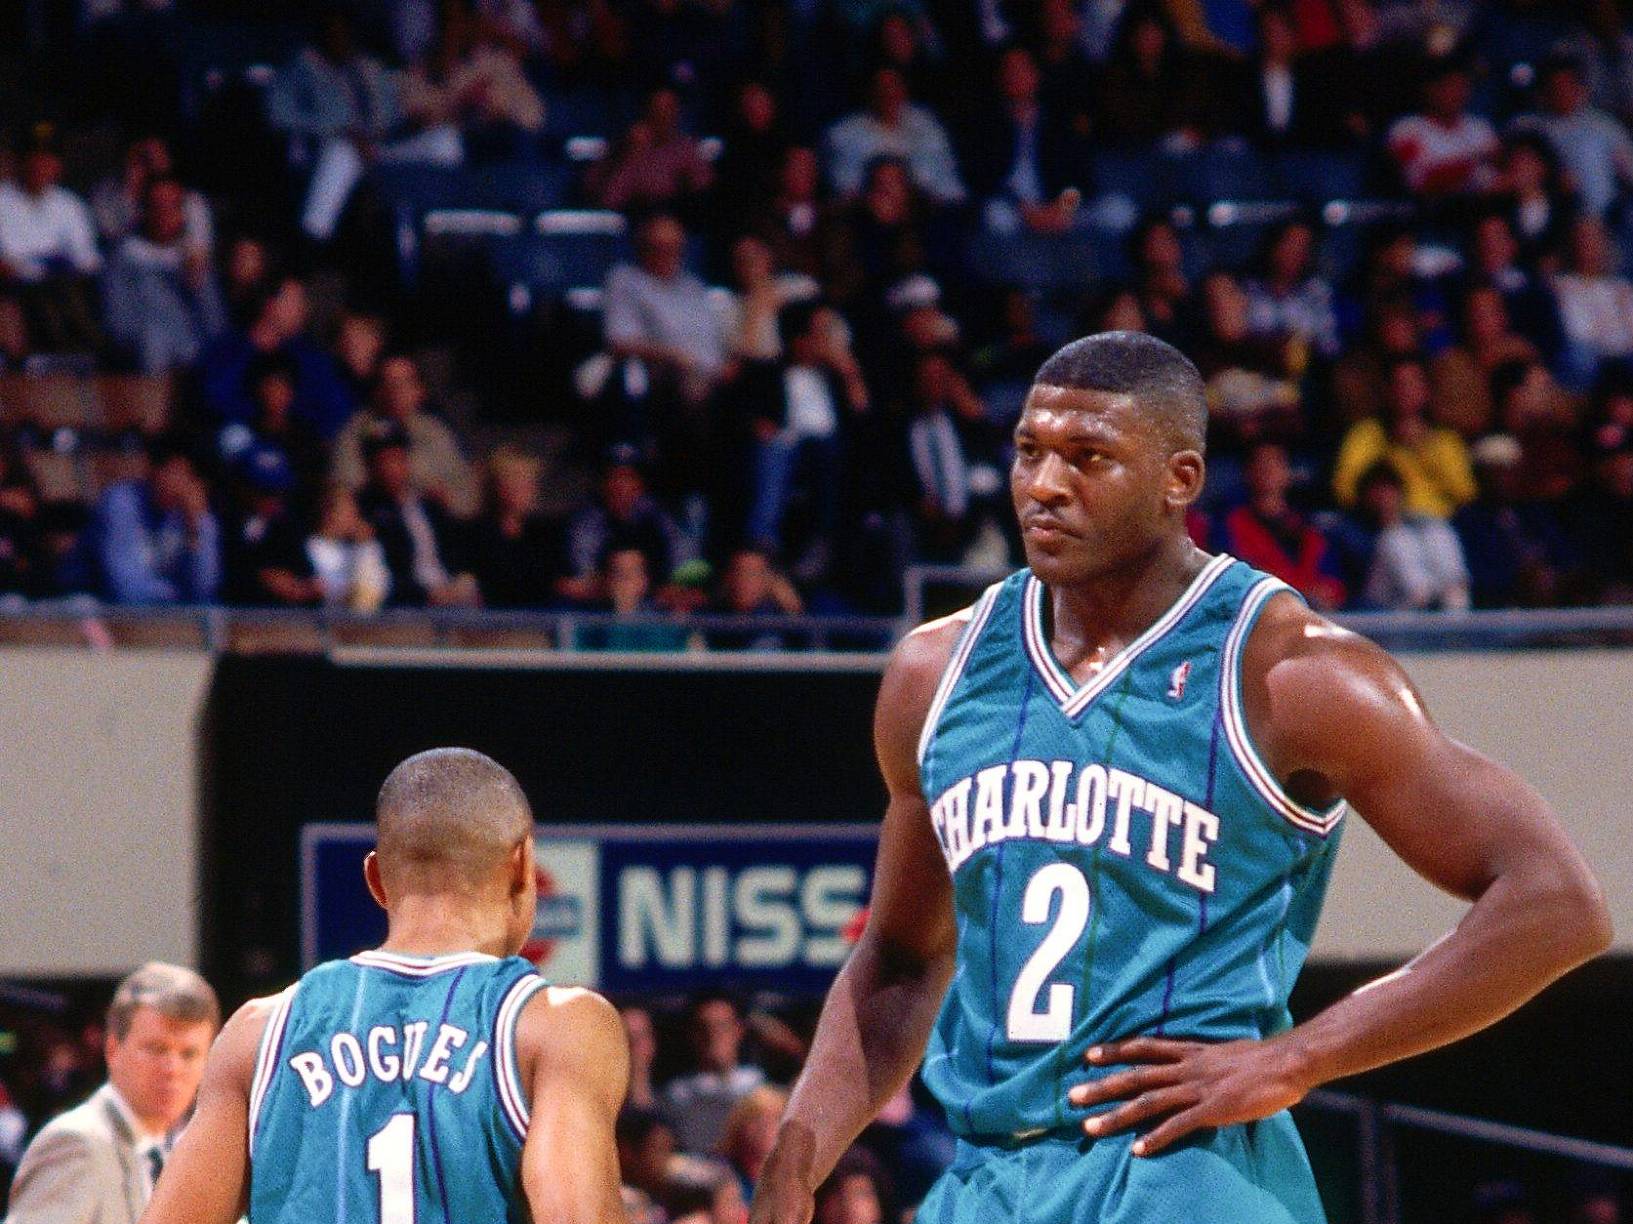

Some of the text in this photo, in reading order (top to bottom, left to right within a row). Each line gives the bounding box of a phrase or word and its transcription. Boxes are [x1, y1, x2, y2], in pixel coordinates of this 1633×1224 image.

[617, 865, 867, 967] NISS
[1006, 861, 1092, 1044] 2
[288, 1019, 490, 1110] BOGUES
